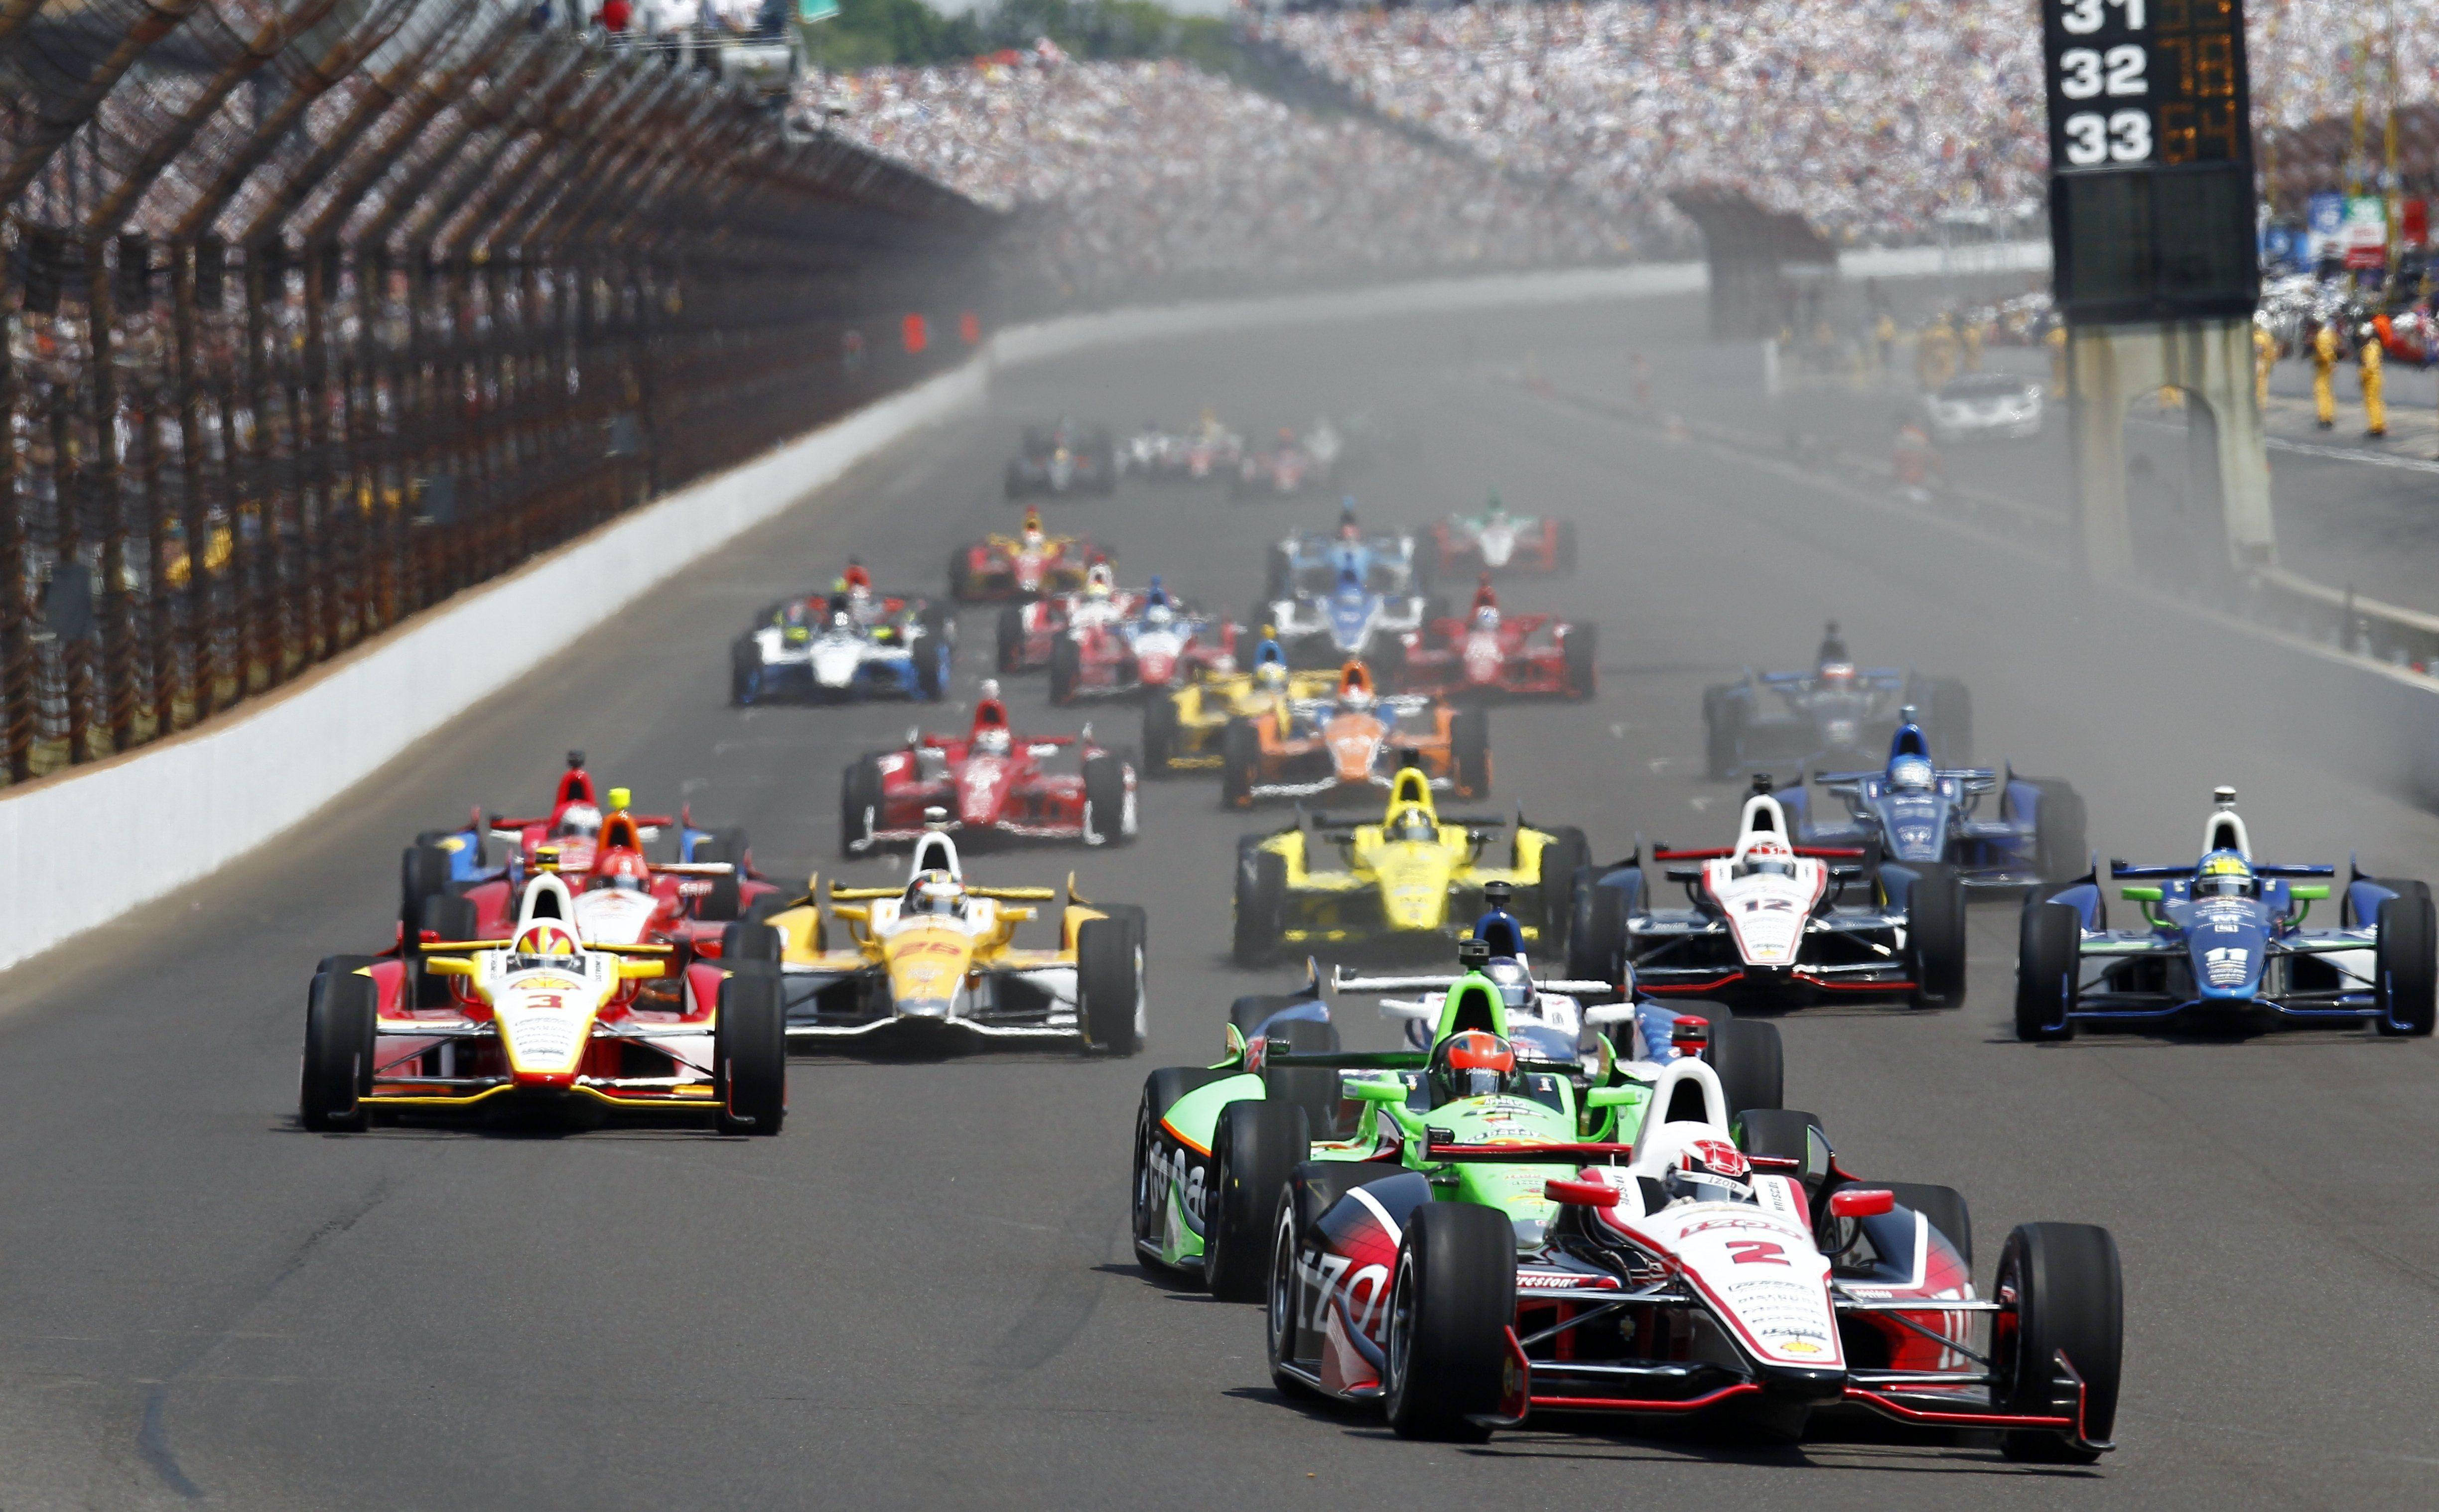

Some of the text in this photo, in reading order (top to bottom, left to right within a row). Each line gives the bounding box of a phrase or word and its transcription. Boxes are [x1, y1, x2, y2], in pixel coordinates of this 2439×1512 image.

[2061, 0, 2147, 35] 31
[2060, 43, 2149, 100] 32
[2064, 107, 2153, 165] 33
[1742, 897, 1794, 914] 12
[2204, 947, 2249, 961] 11
[527, 994, 563, 1009] 3
[1708, 1176, 1738, 1190] IZOD
[1725, 1240, 1791, 1266] 2
[1516, 1276, 1579, 1288] restone
